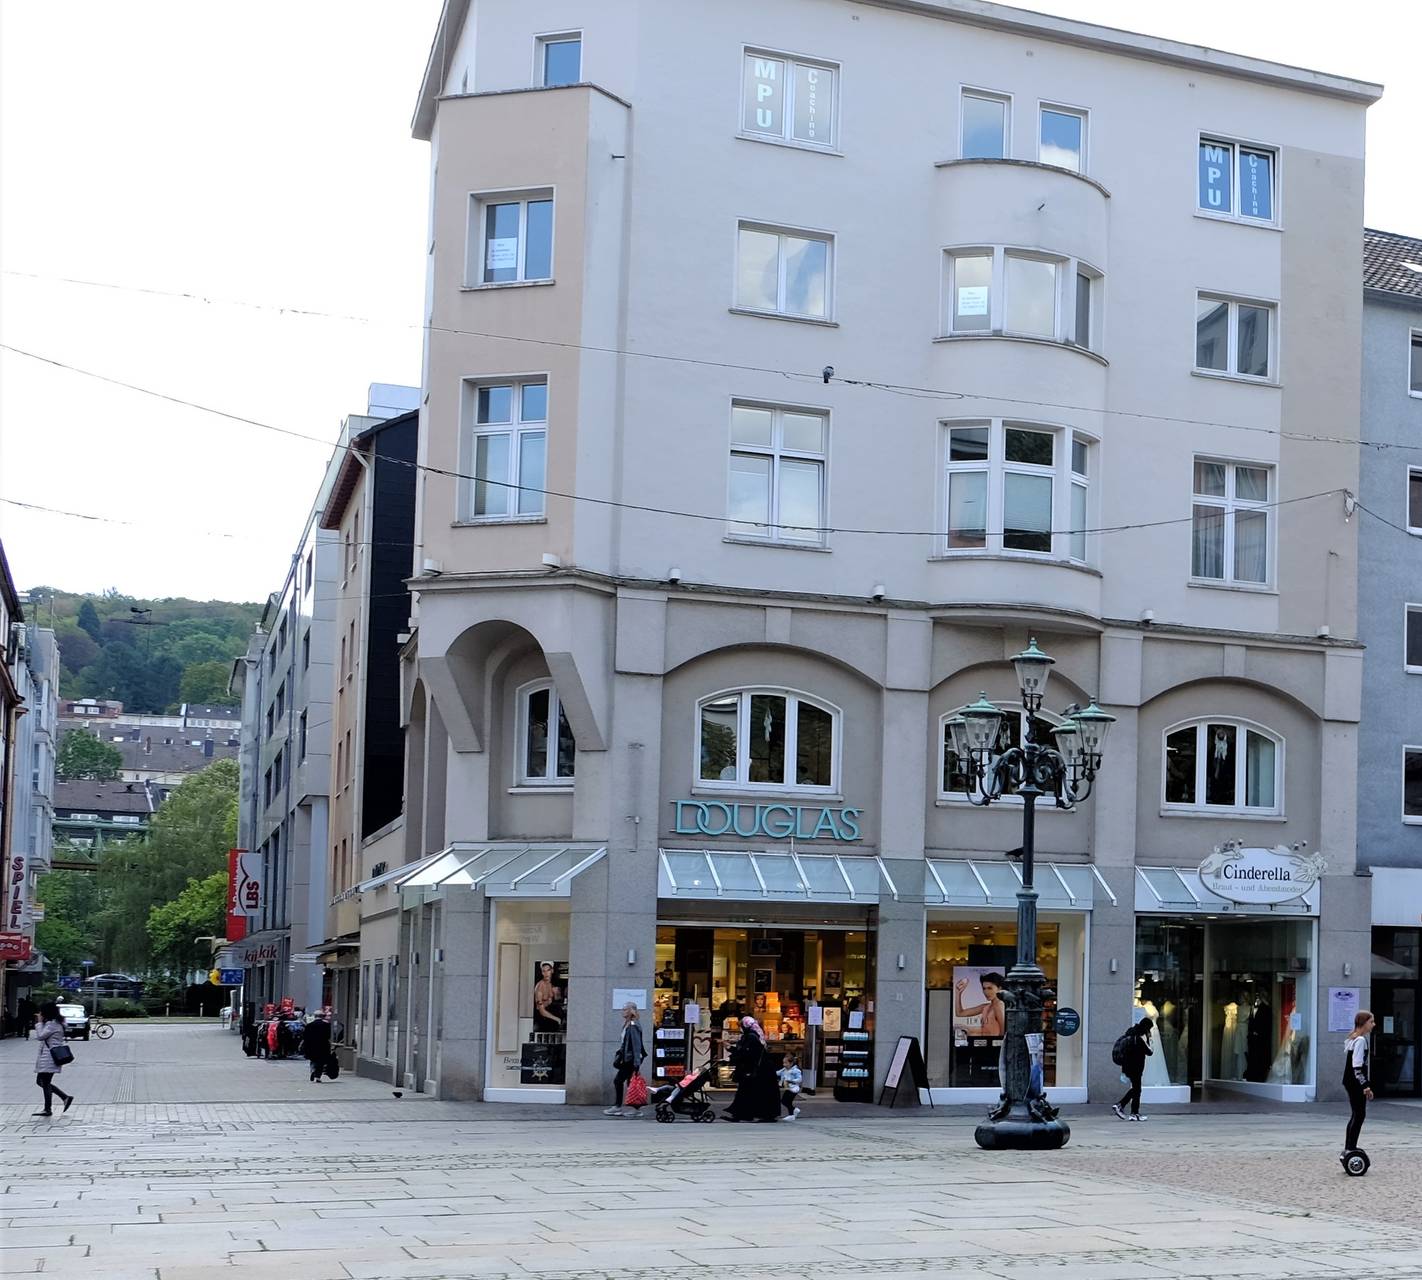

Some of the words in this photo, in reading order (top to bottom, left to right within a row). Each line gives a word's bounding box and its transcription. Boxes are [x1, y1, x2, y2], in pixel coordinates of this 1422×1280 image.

[754, 60, 776, 128] MPU
[808, 70, 818, 137] Coaching
[1205, 145, 1223, 206] MPU
[1248, 154, 1258, 216] Coaching
[676, 801, 860, 841] DOUGLAS
[1212, 883, 1232, 891] Braut
[1241, 883, 1255, 892] und
[1223, 864, 1291, 881] Cinderella
[10, 856, 25, 930] SPIEL
[245, 881, 260, 910] LBS
